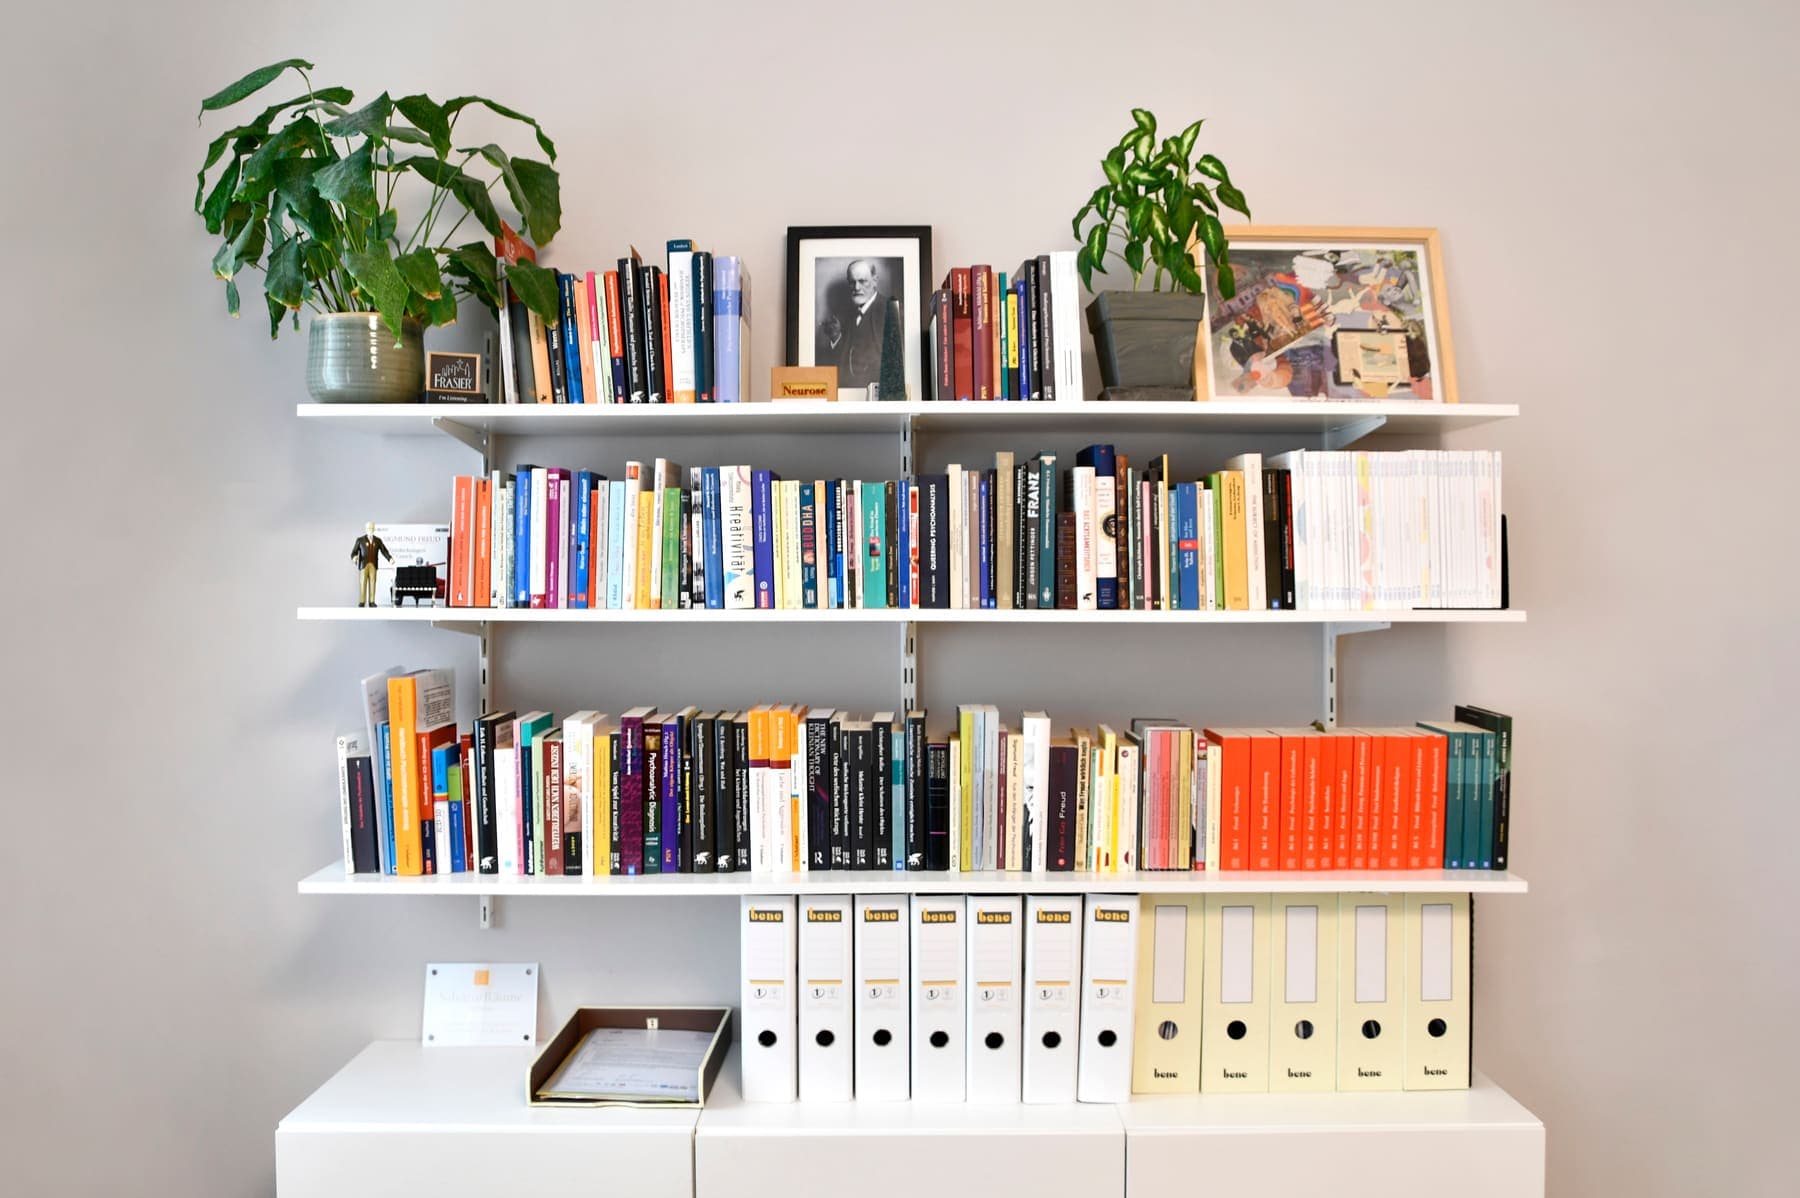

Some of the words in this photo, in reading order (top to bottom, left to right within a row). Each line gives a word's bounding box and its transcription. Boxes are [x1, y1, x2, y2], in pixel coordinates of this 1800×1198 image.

[434, 373, 473, 390] FRASIER
[783, 386, 827, 396] Neurose
[1027, 472, 1039, 518] FRANZ
[729, 506, 746, 572] Kreativität
[550, 744, 559, 768] INZEST
[647, 752, 657, 800] Psychoanalytic
[815, 766, 821, 775] OF
[647, 801, 657, 833] Diagnosis
[750, 907, 782, 921] bene
[808, 907, 841, 921] bene
[865, 907, 897, 920] bene
[923, 908, 954, 922] bene
[978, 908, 1010, 922] bene
[1037, 908, 1070, 922] bene
[1096, 906, 1128, 921] bene
[1154, 1068, 1178, 1078] bene
[1223, 1069, 1247, 1079] bene
[1287, 1068, 1312, 1078] bene
[1357, 1067, 1382, 1077] bene
[1424, 1066, 1448, 1076] bene
